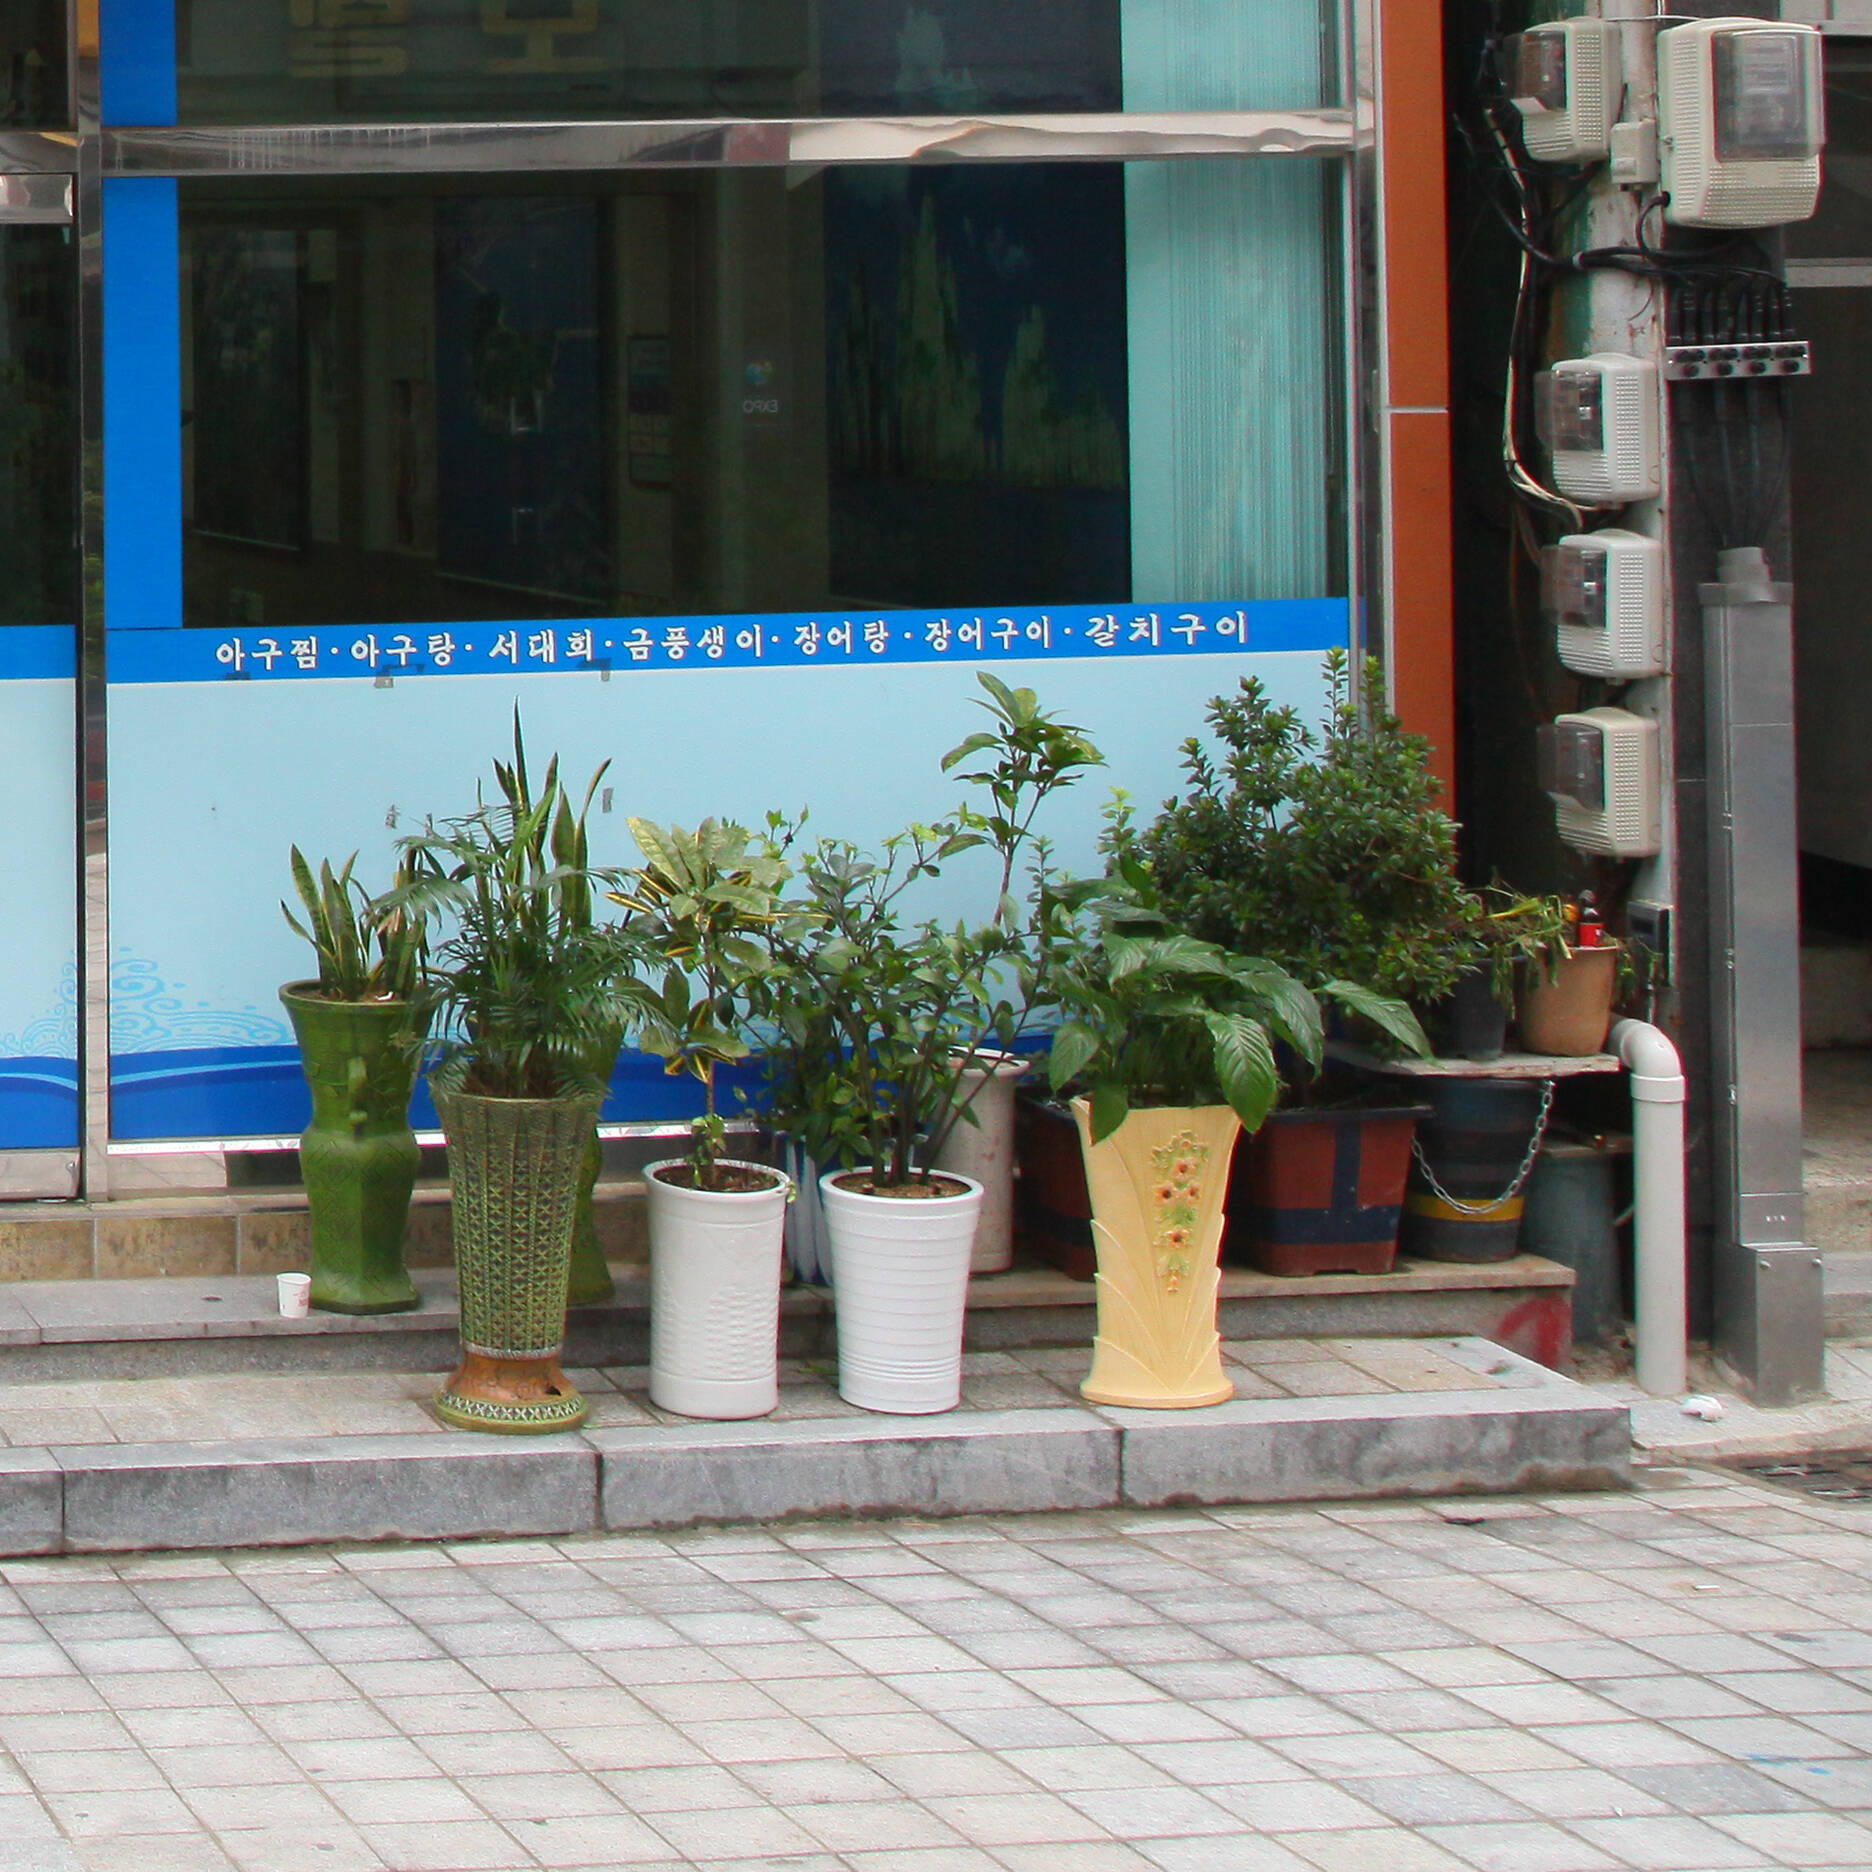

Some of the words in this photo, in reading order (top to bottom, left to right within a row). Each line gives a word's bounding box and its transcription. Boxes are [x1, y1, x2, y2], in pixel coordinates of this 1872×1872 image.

[216, 636, 317, 671] 아구찜
[351, 632, 456, 668] 아구탕
[489, 629, 592, 664] 서대회
[623, 624, 774, 660] 금풍생이
[794, 620, 889, 655] 장어탕
[925, 615, 1049, 652] 장어구이
[1085, 611, 1245, 647] 갈치구이
